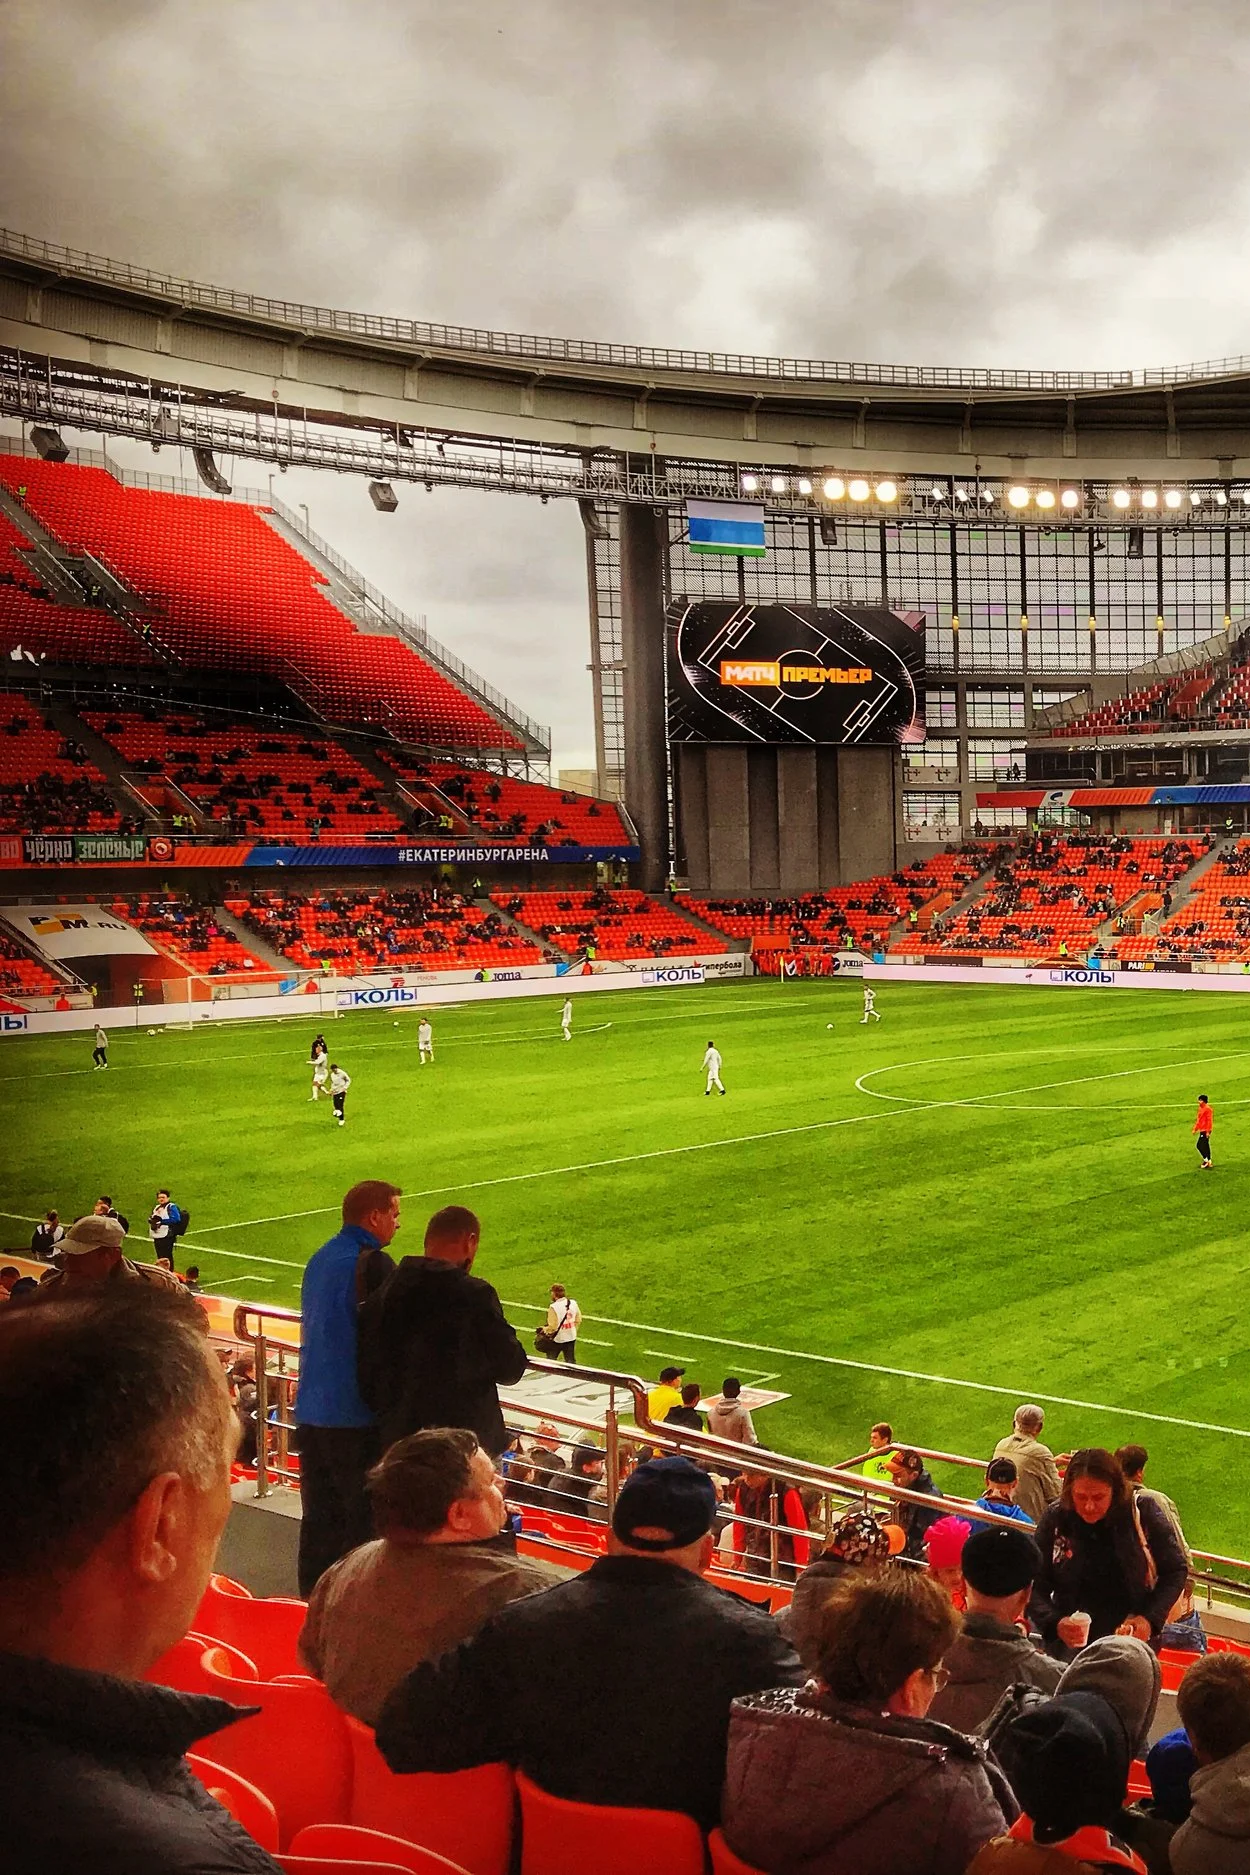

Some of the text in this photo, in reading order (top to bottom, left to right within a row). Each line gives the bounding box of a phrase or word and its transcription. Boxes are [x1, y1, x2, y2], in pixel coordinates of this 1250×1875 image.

[725, 665, 872, 684] МАТЧ ПРЕМЬЕР
[398, 847, 549, 863] #ЕКАТЕРИНБУРГАРЕНА
